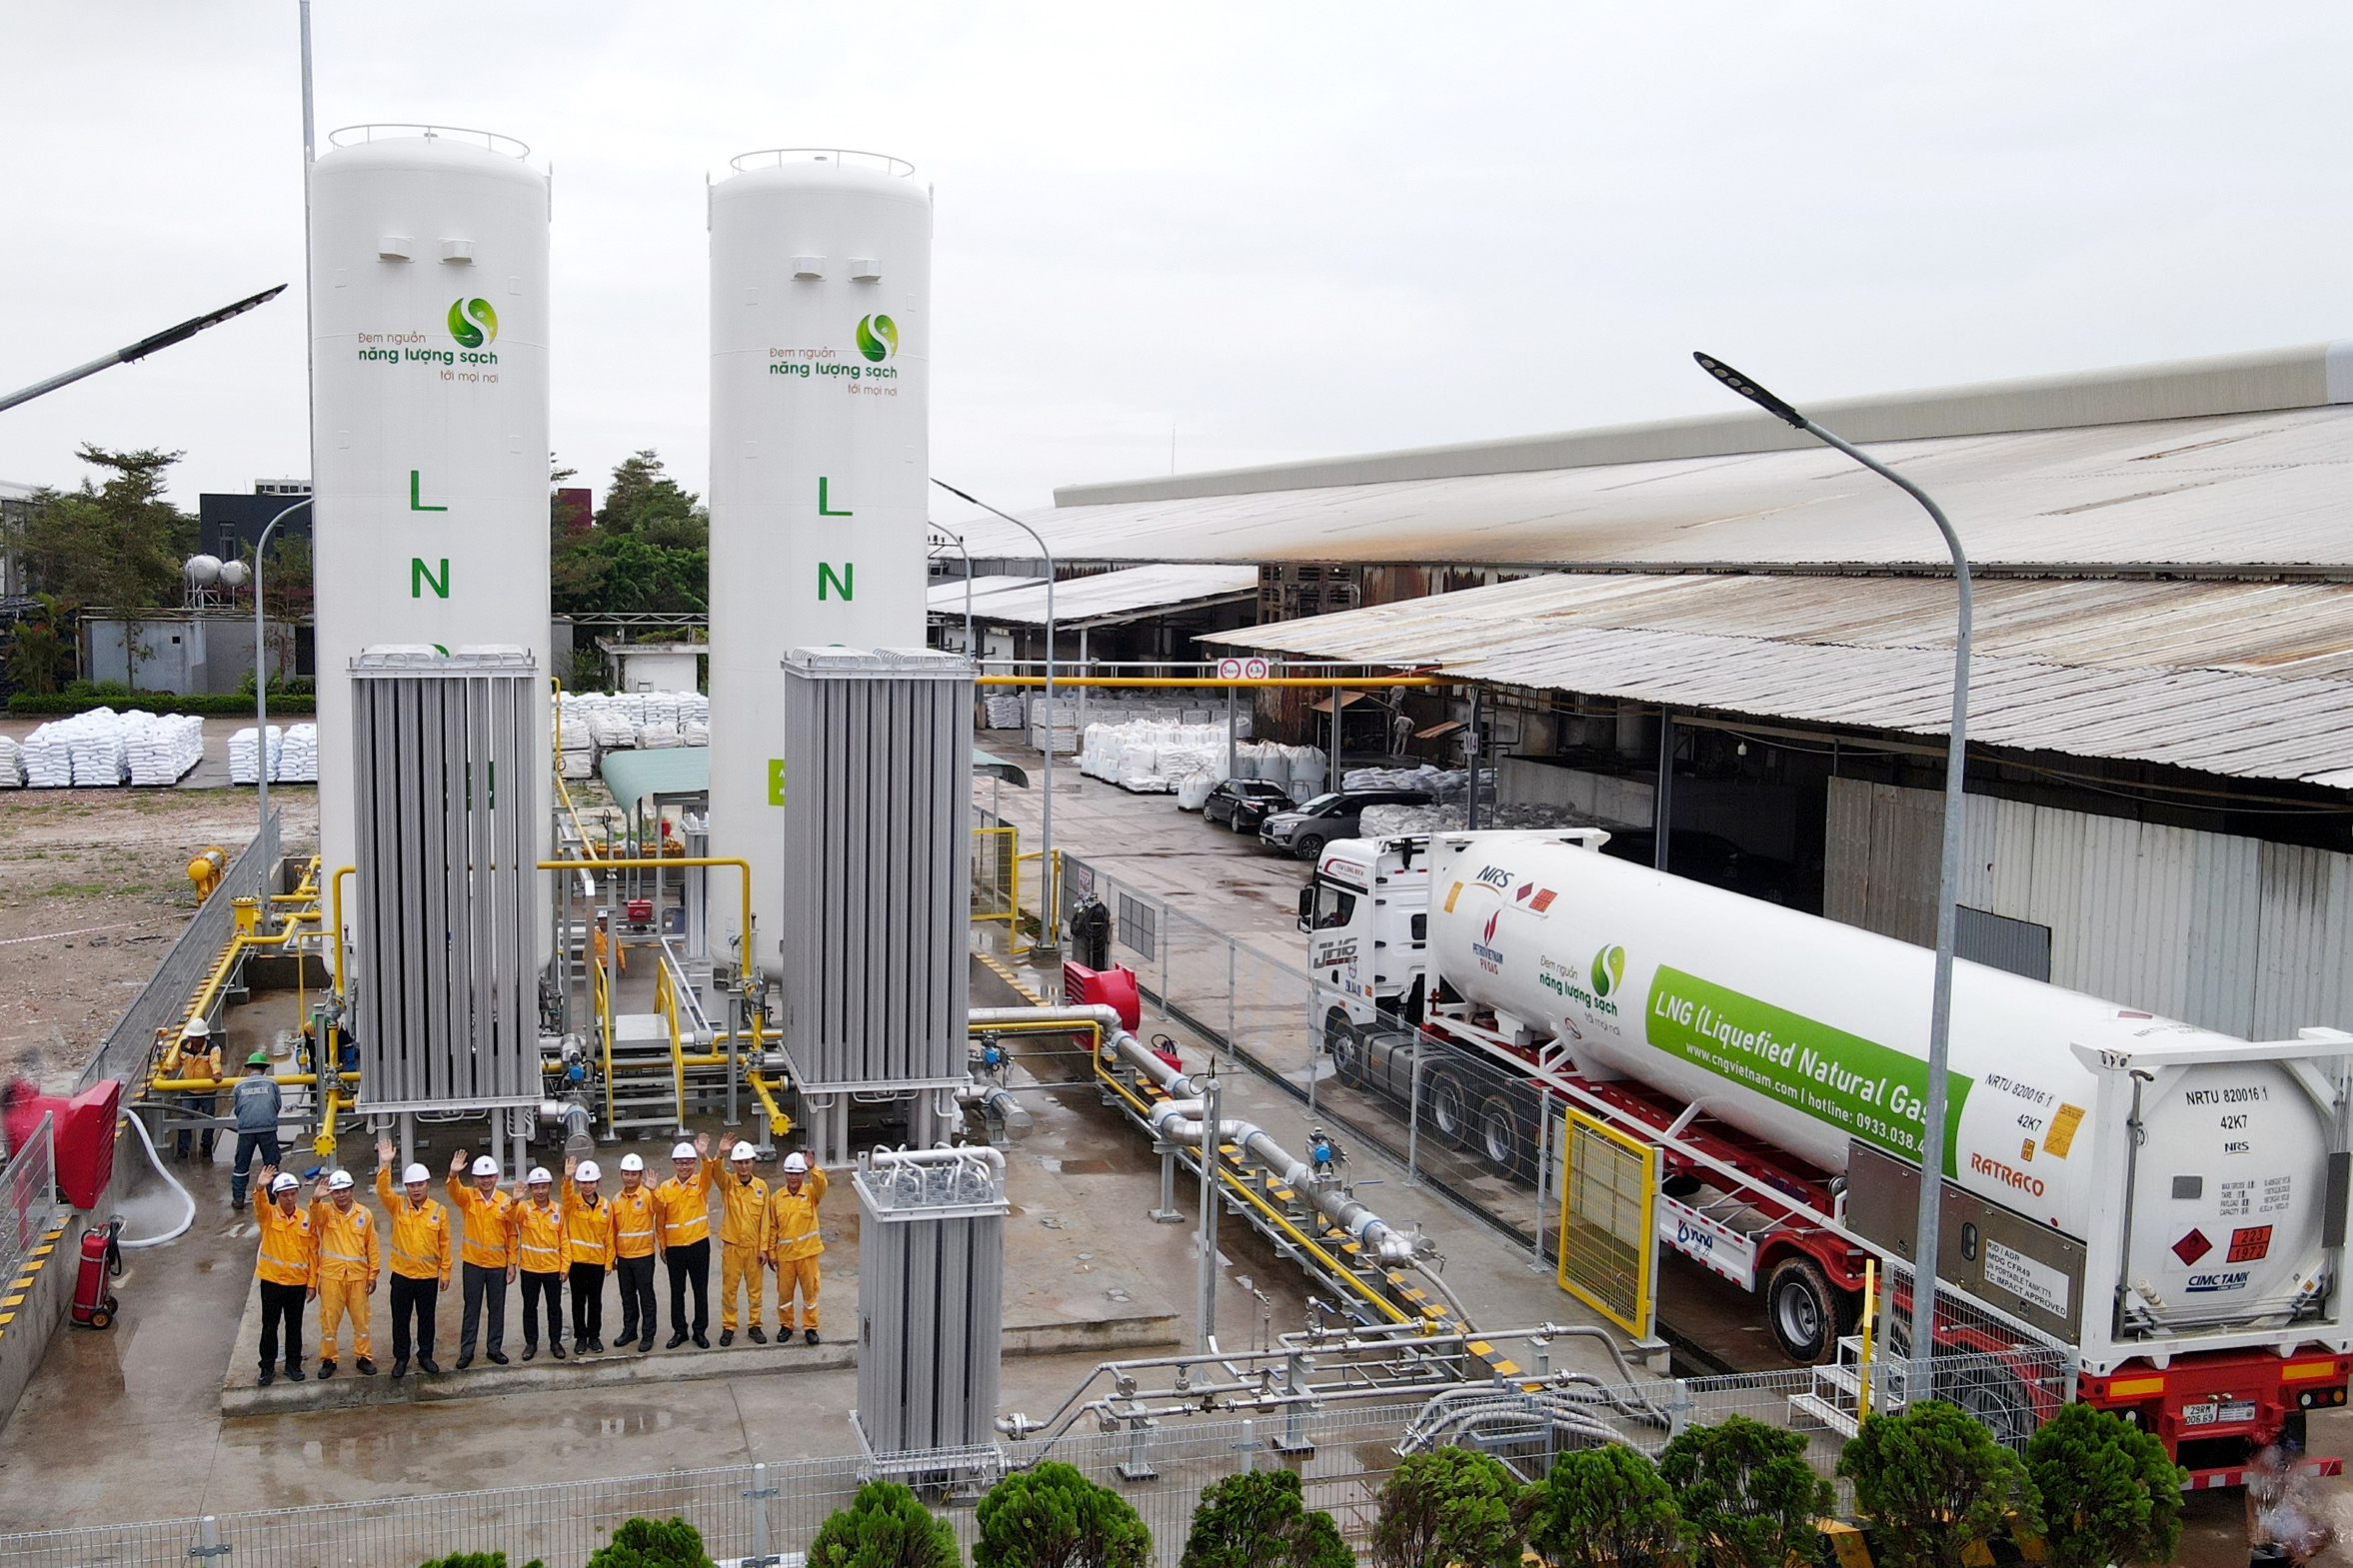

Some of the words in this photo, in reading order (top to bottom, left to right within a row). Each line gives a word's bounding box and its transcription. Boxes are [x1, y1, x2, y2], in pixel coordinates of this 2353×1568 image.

[358, 332, 384, 344] Đem
[387, 331, 426, 345] nguồn
[358, 347, 399, 364] năng
[405, 348, 454, 366] lượng
[460, 351, 498, 367] sạch
[770, 347, 795, 358] Đem
[440, 369, 454, 381] tới
[459, 371, 479, 383] mọi
[483, 372, 499, 384] nơi
[770, 361, 810, 378] năng
[816, 362, 861, 380] lượng
[866, 366, 898, 381] sạch
[848, 383, 861, 395] tới
[864, 385, 882, 397] mọi
[885, 386, 898, 397] nơi
[1476, 864, 1514, 888] NRS
[1540, 955, 1555, 970] Đem
[1539, 972, 1562, 995] năng
[1565, 981, 1591, 1008] lượng
[1594, 997, 1617, 1016] sạch
[1654, 991, 1693, 1026] LNG
[1695, 1004, 1797, 1068] (Liquefied
[1797, 1047, 1887, 1106] Natural
[1985, 1073, 2013, 1091] NRTU
[2012, 1083, 2045, 1104] 820016
[2186, 1089, 2219, 1105] NRTU
[2223, 1087, 2260, 1103] 820016
[1686, 1042, 1798, 1100] www.cngvietnam.com
[1808, 1091, 1853, 1124] hotline:
[1856, 1112, 1924, 1154] 0933.038.4
[2017, 1114, 2042, 1132] 42K7
[2220, 1114, 2248, 1129] 42K7
[2224, 1141, 2249, 1152] NRS
[1970, 1152, 2044, 1197] RATRACO
[2241, 1229, 2263, 1243] 223
[2004, 1250, 2020, 1262] ADR
[2234, 1245, 2264, 1259] 1972
[1986, 1252, 2005, 1265] IMDG
[2006, 1261, 2031, 1277] CFR49
[1995, 1265, 2024, 1285] PORTABLE
[2188, 1274, 2221, 1286] CIMC
[2221, 1271, 2250, 1284] TANK
[1986, 1270, 1995, 1280] TC
[1996, 1276, 2023, 1294] IMPACT
[2024, 1290, 2066, 1315] APPROVED
